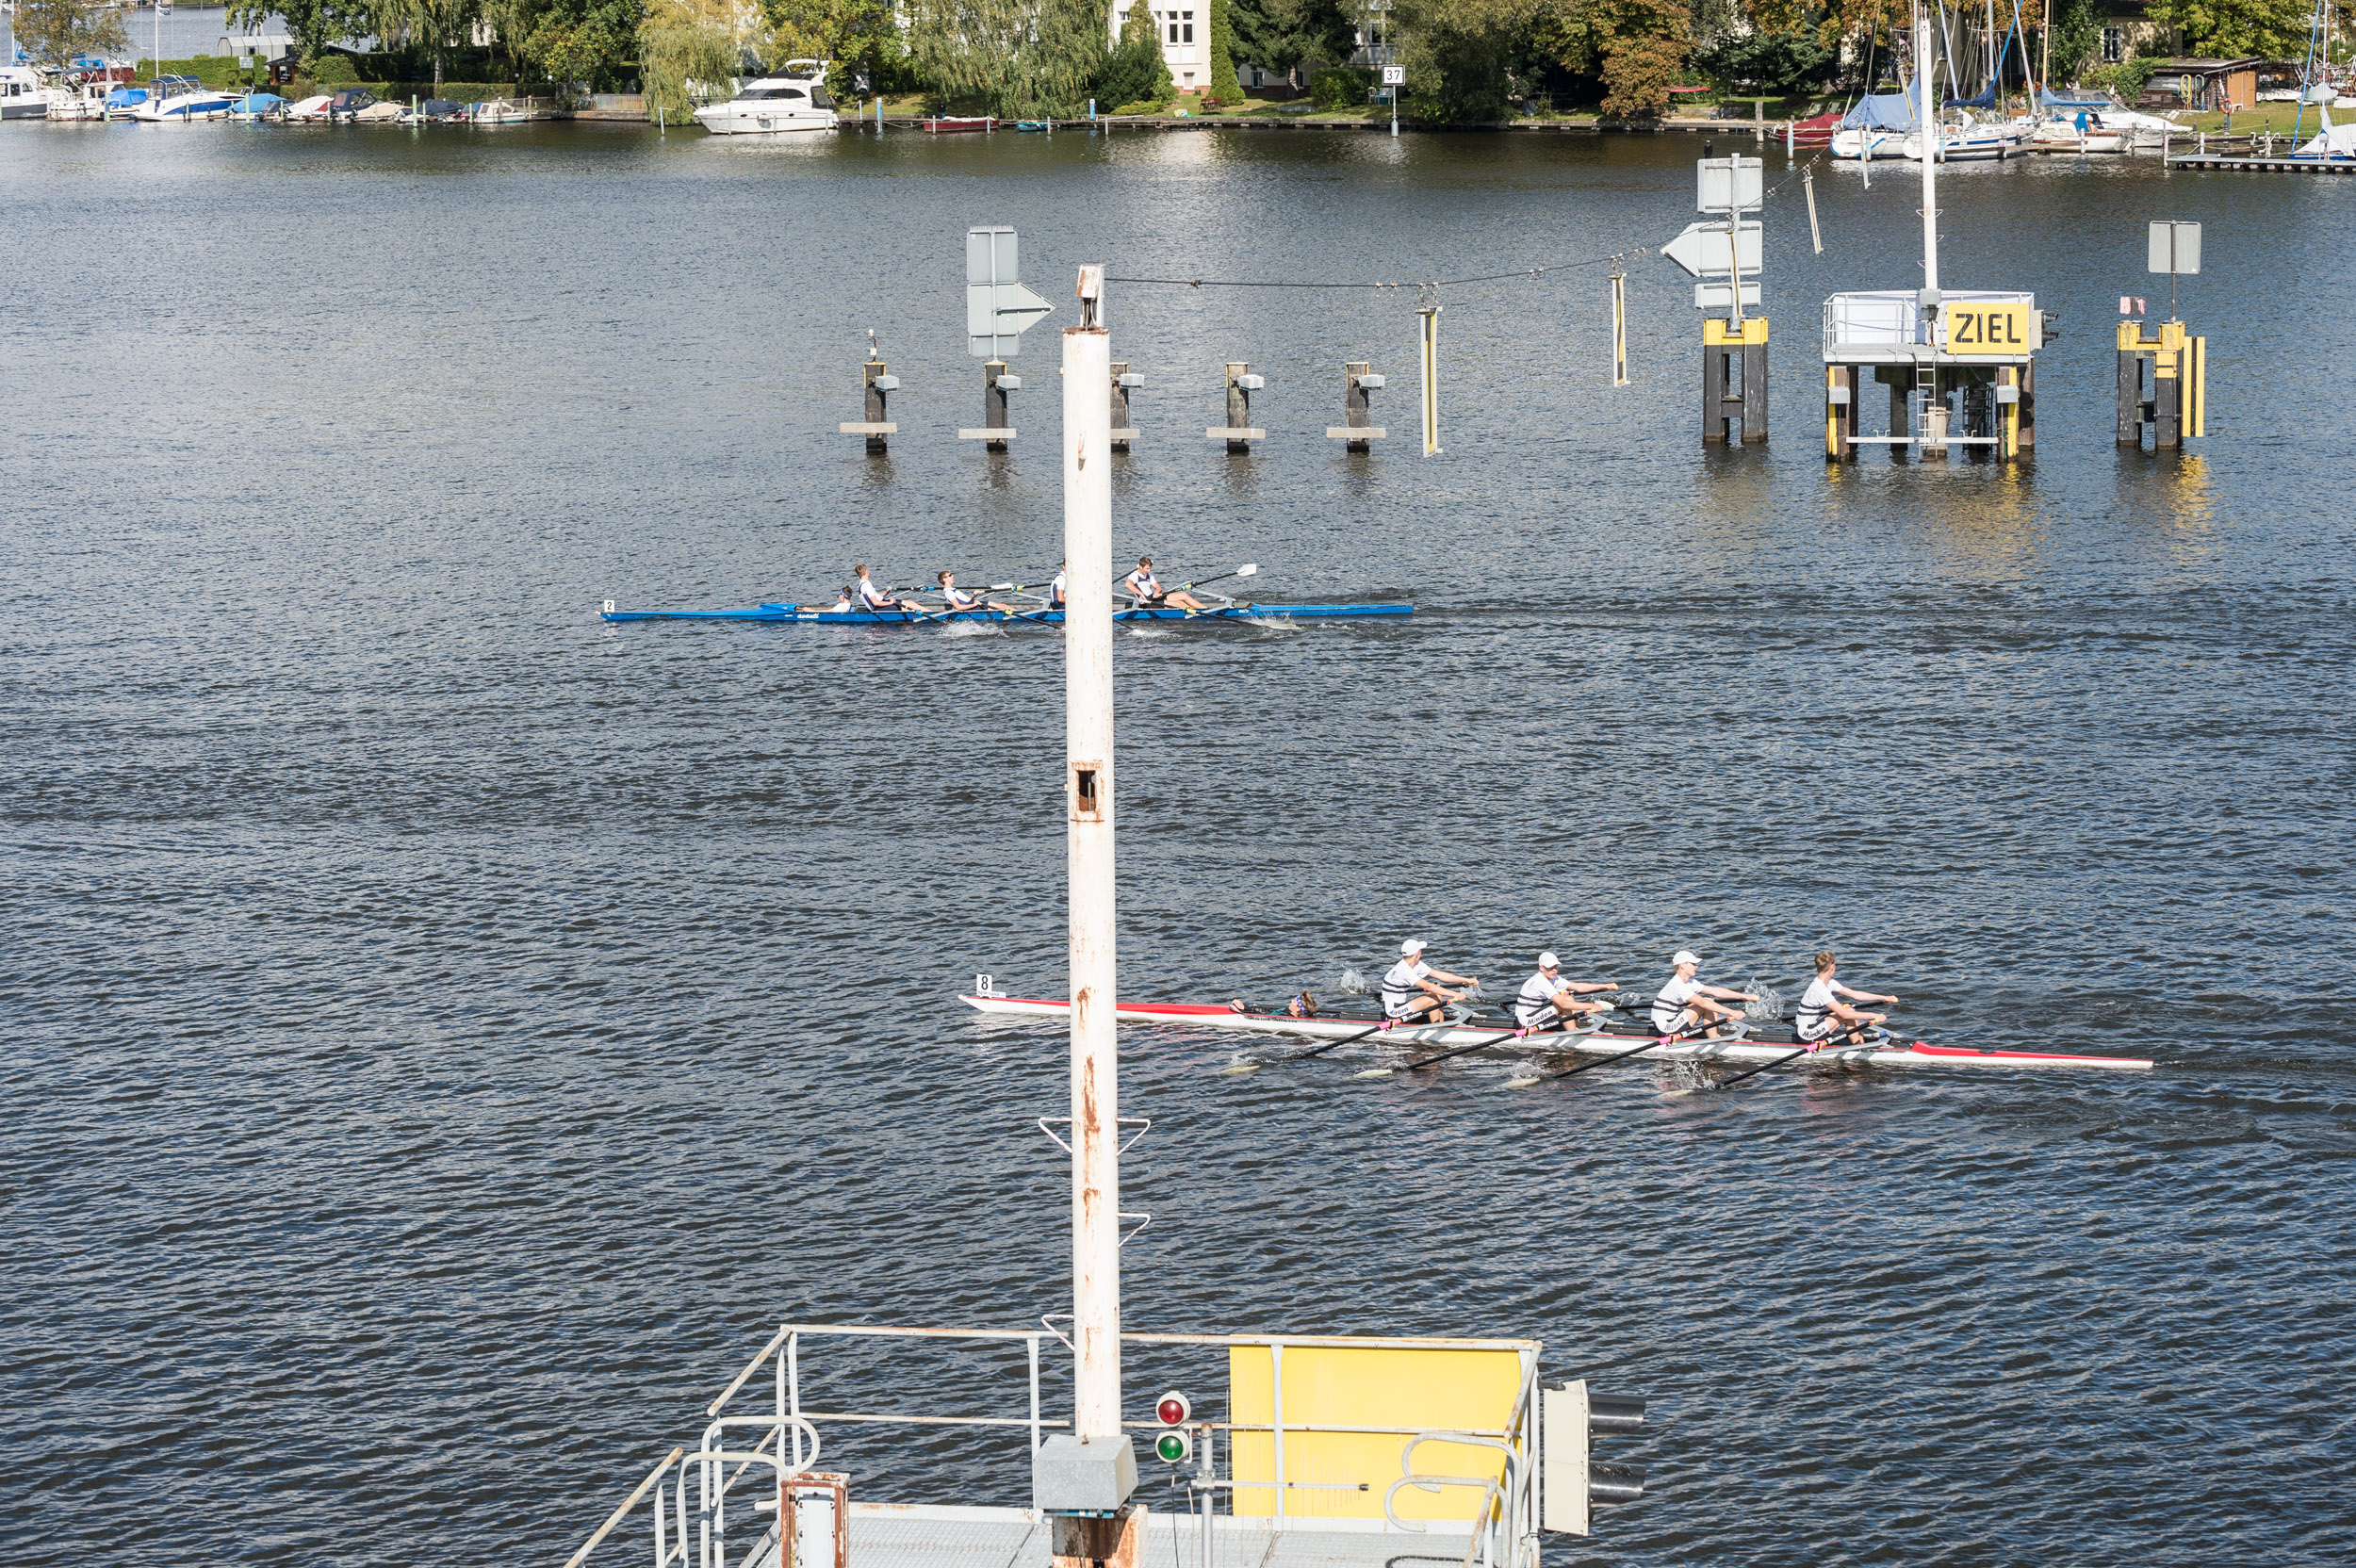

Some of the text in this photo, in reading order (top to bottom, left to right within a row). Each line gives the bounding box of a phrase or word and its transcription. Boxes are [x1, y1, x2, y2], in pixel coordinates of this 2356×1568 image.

[1386, 70, 1400, 80] 37
[1955, 313, 2021, 343] ZIEL
[607, 601, 613, 610] 2
[981, 975, 989, 989] 8
[1527, 1010, 1553, 1025] Minden
[1802, 1027, 1826, 1039] Minden
